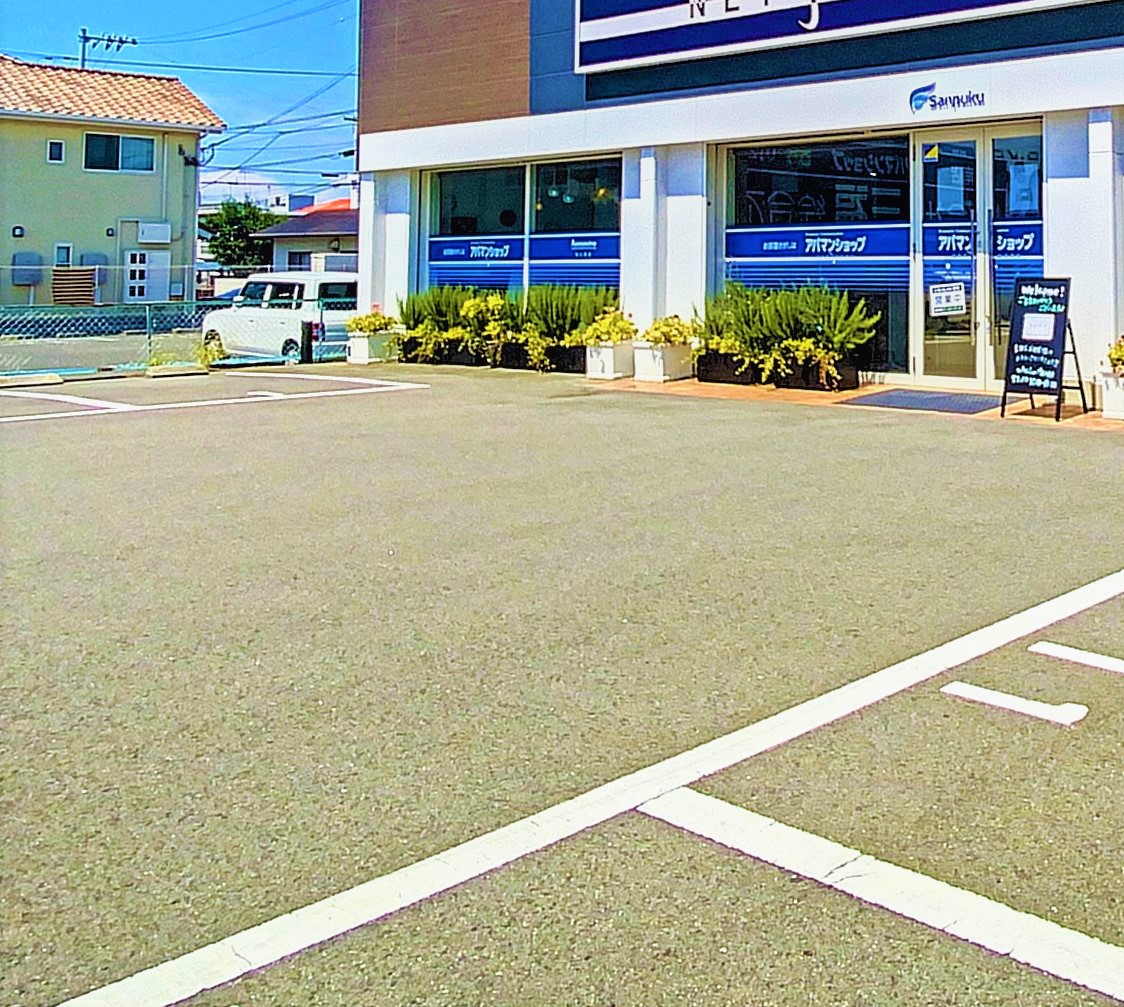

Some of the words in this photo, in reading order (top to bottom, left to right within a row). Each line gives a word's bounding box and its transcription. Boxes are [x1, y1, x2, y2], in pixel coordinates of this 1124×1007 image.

[805, 236, 866, 253] アパマンショップ
